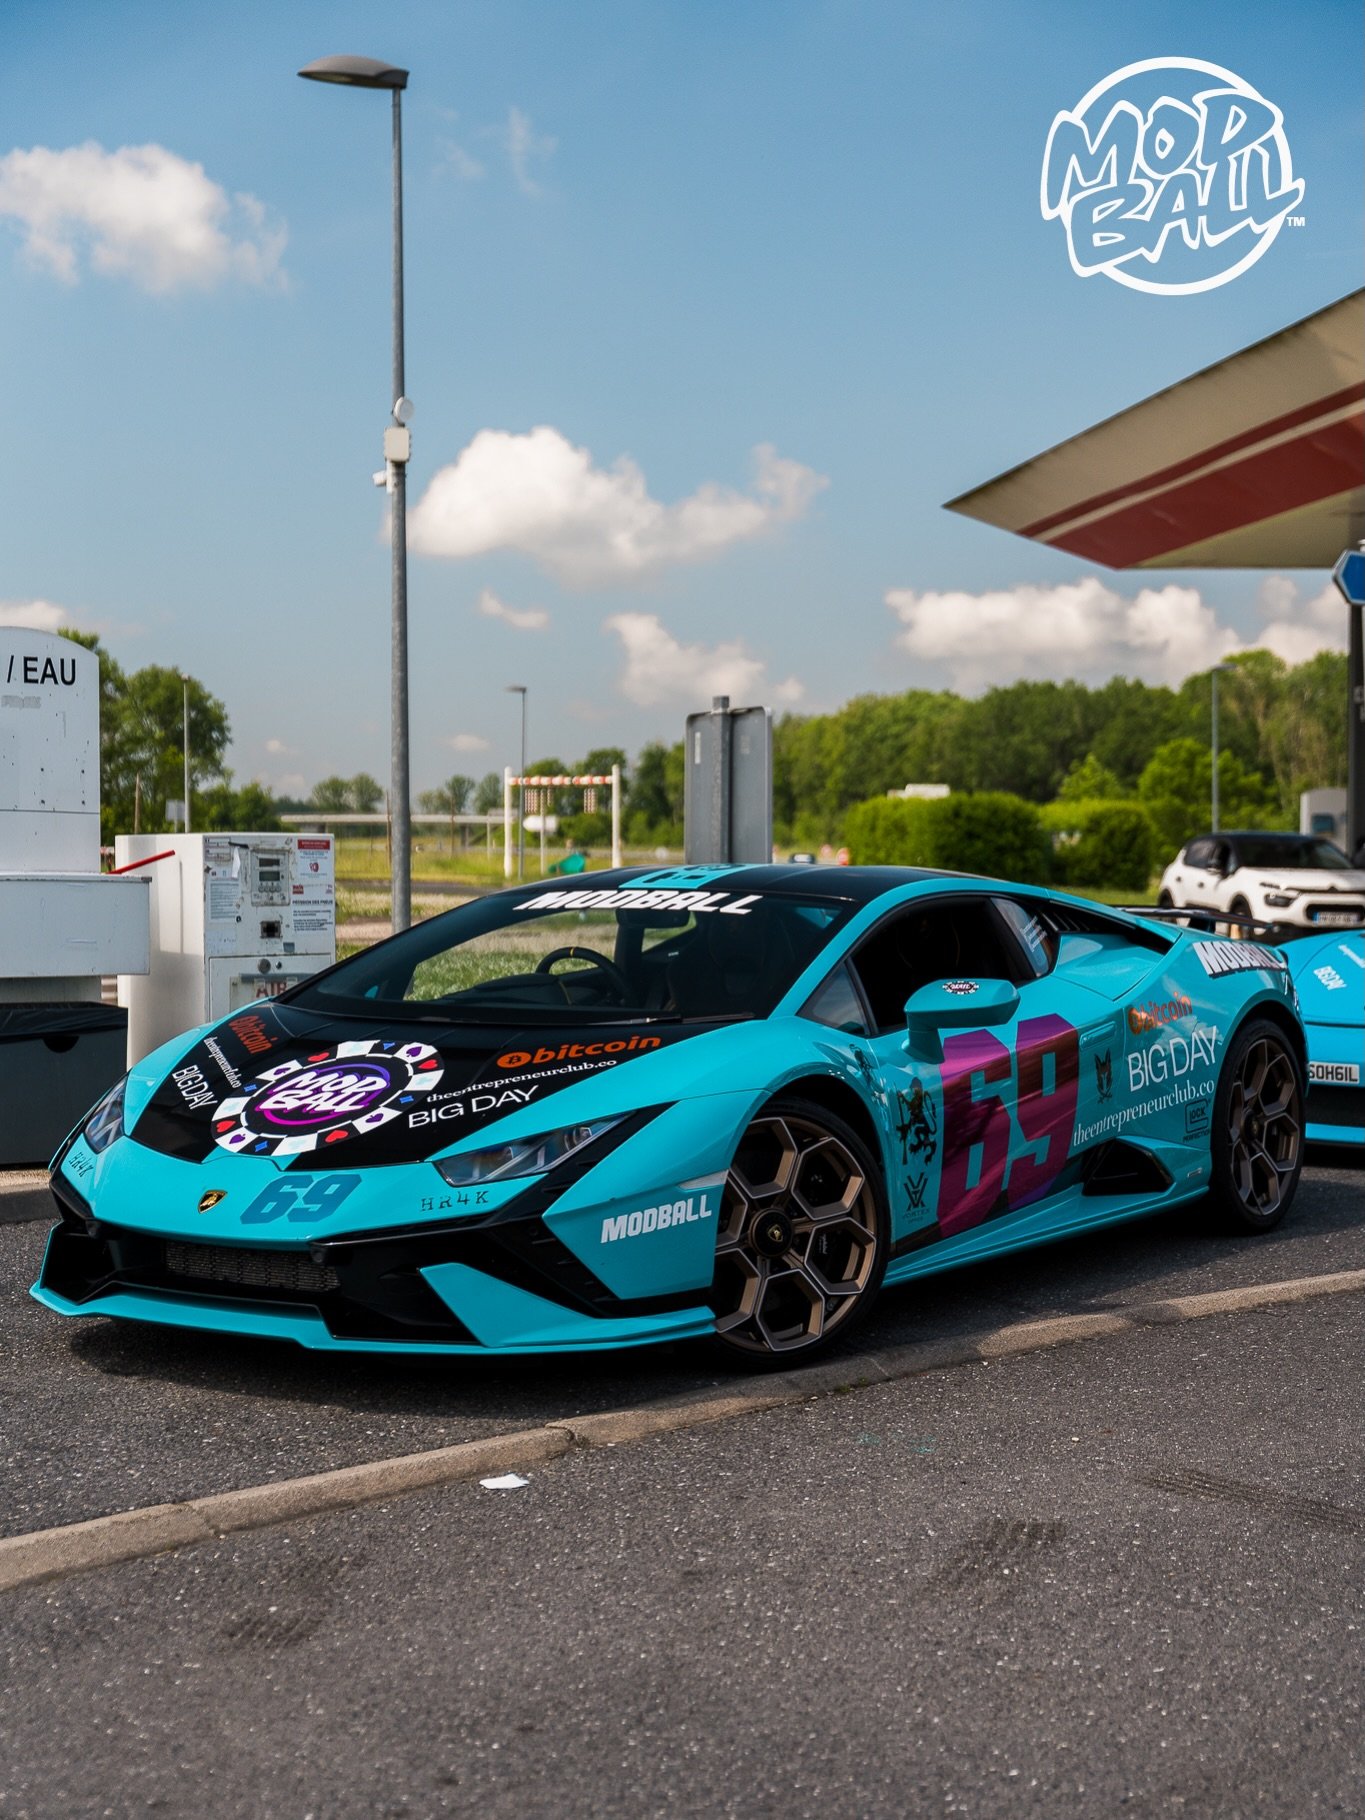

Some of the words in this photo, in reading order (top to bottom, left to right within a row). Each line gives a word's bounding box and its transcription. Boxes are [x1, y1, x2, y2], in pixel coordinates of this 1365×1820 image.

[23, 656, 76, 685] EAU
[513, 890, 763, 915] MODBALL
[1140, 991, 1193, 1031] bitcoin
[531, 1036, 662, 1064] bitcoin
[1128, 1044, 1168, 1092] BIG
[1169, 1025, 1217, 1077] DAY
[172, 1064, 204, 1089] BIG
[269, 1070, 389, 1093] MOD
[426, 1059, 617, 1103] theentrepreneurclub.co
[181, 1081, 218, 1110] DAY
[256, 1089, 368, 1113] BALL
[408, 1100, 464, 1128] BIG
[471, 1085, 539, 1113] DAY
[936, 1013, 1079, 1237] 69
[1073, 1079, 1215, 1147] theentrepreneurclub.co
[240, 1174, 362, 1224] 69
[421, 1190, 489, 1211] HR4K
[601, 1194, 712, 1243] MODBALL
